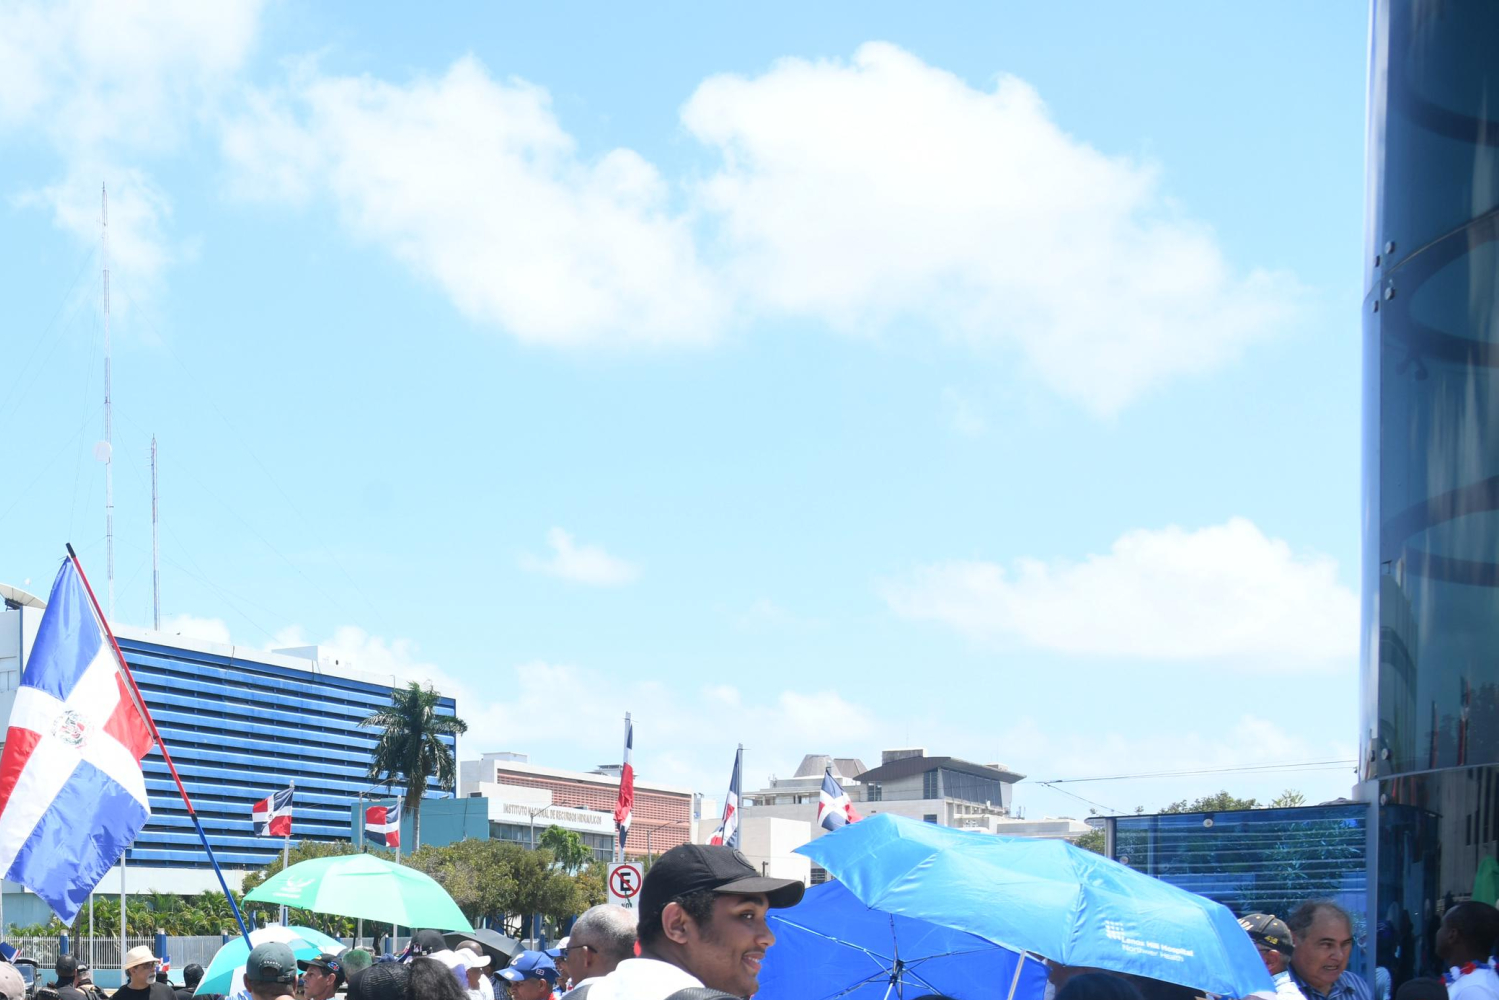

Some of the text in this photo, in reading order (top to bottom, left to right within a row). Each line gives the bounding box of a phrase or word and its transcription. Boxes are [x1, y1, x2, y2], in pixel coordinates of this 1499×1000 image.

[503, 803, 528, 816] INSTITUTO
[550, 809, 556, 820] DE
[620, 872, 632, 891] E
[1160, 944, 1194, 957] Hospital
